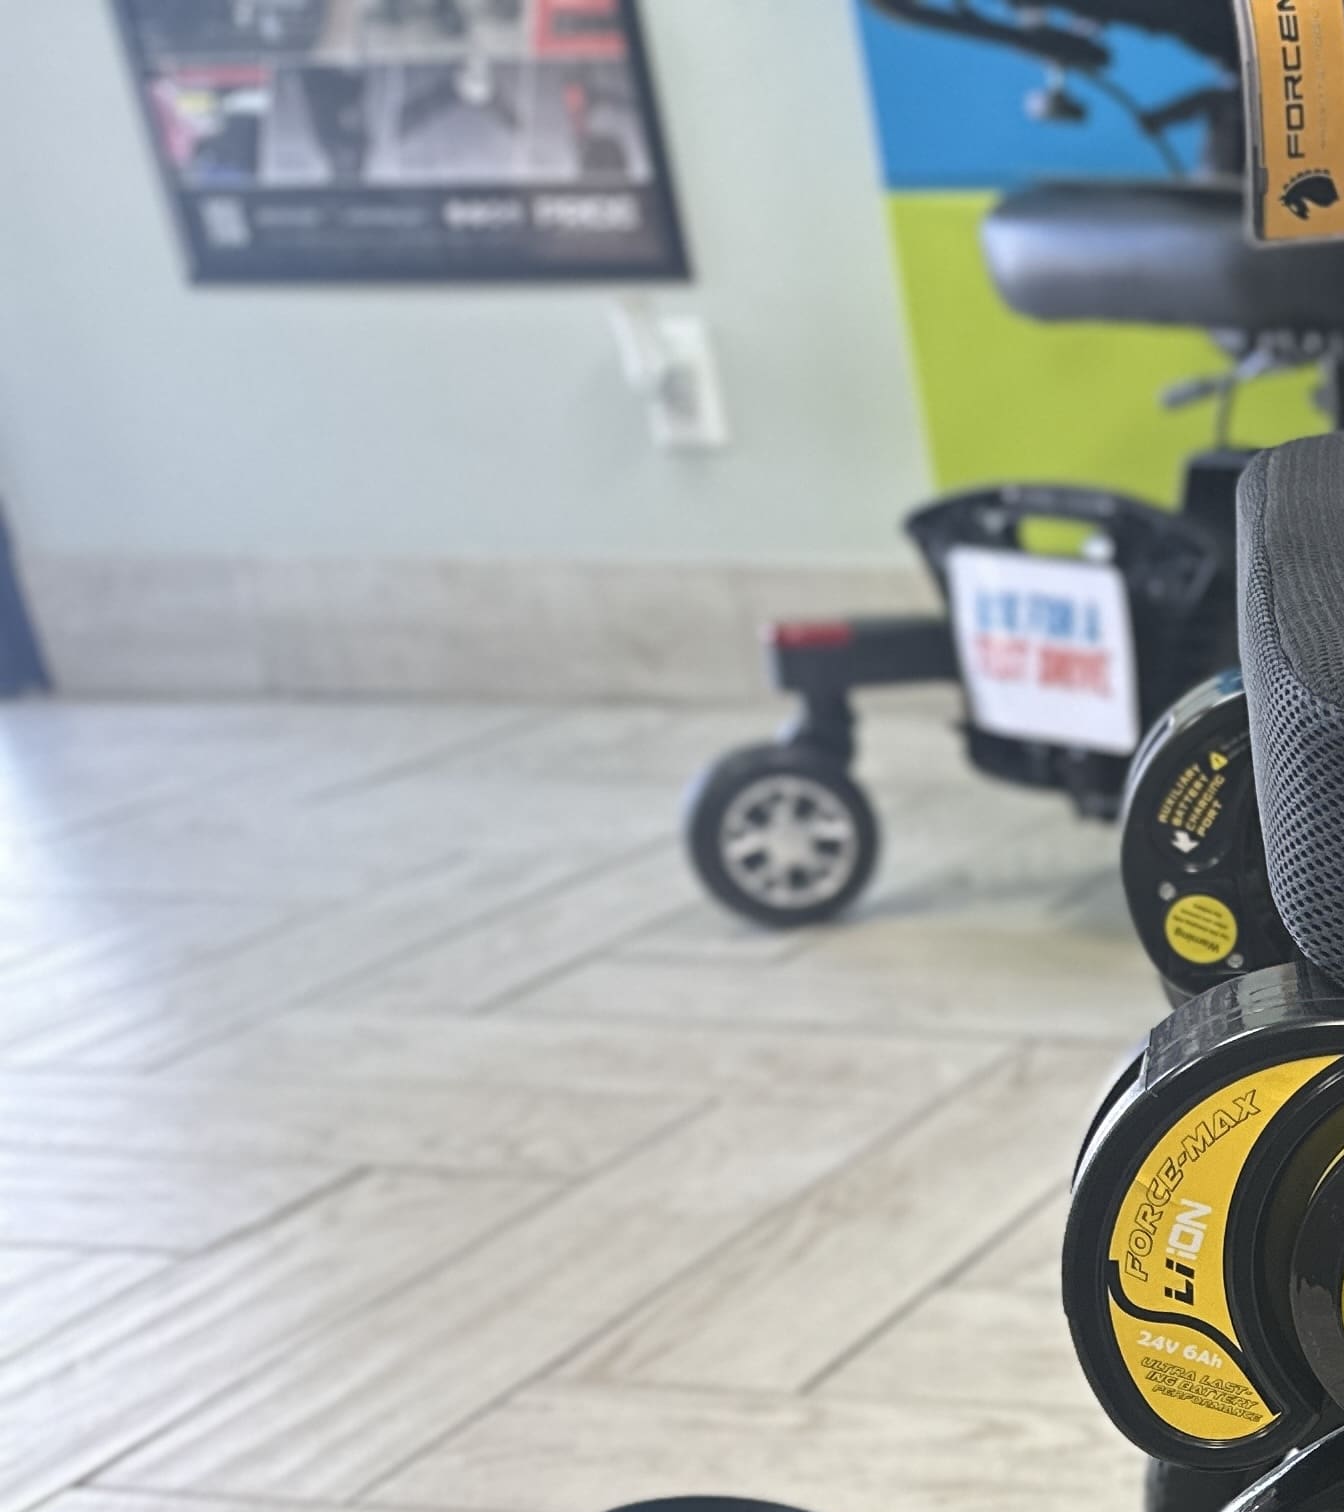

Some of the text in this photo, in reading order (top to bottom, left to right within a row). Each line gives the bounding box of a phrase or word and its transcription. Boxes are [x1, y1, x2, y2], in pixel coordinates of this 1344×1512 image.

[1171, 773, 1208, 827] BATTERY
[1185, 774, 1226, 832] CHARGING
[1196, 799, 1222, 837] PORT
[1124, 1089, 1261, 1282] FORCE-MAX
[1136, 1329, 1223, 1369] 24V 6Ah
[1141, 1357, 1197, 1382] ULTRA
[1145, 1370, 1260, 1410] ING BATTERY
[1152, 1384, 1264, 1423] PERFORMANCE
